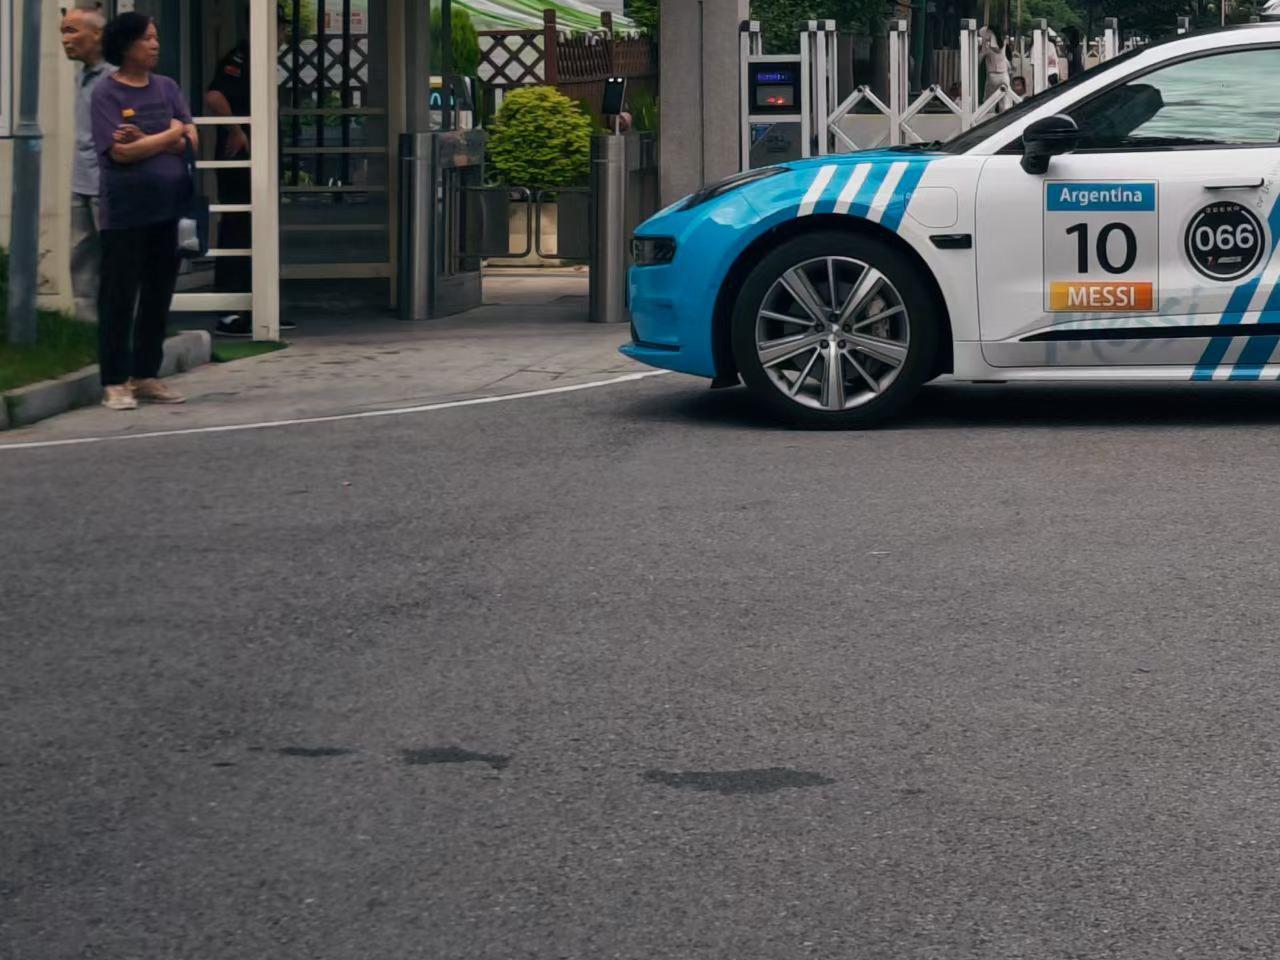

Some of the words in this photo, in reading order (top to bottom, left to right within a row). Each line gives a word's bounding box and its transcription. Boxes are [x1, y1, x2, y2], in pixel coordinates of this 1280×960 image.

[1059, 187, 1143, 206] Argentina
[1065, 221, 1138, 275] 10
[1195, 223, 1255, 252] 066
[1067, 286, 1136, 307] MESSI
